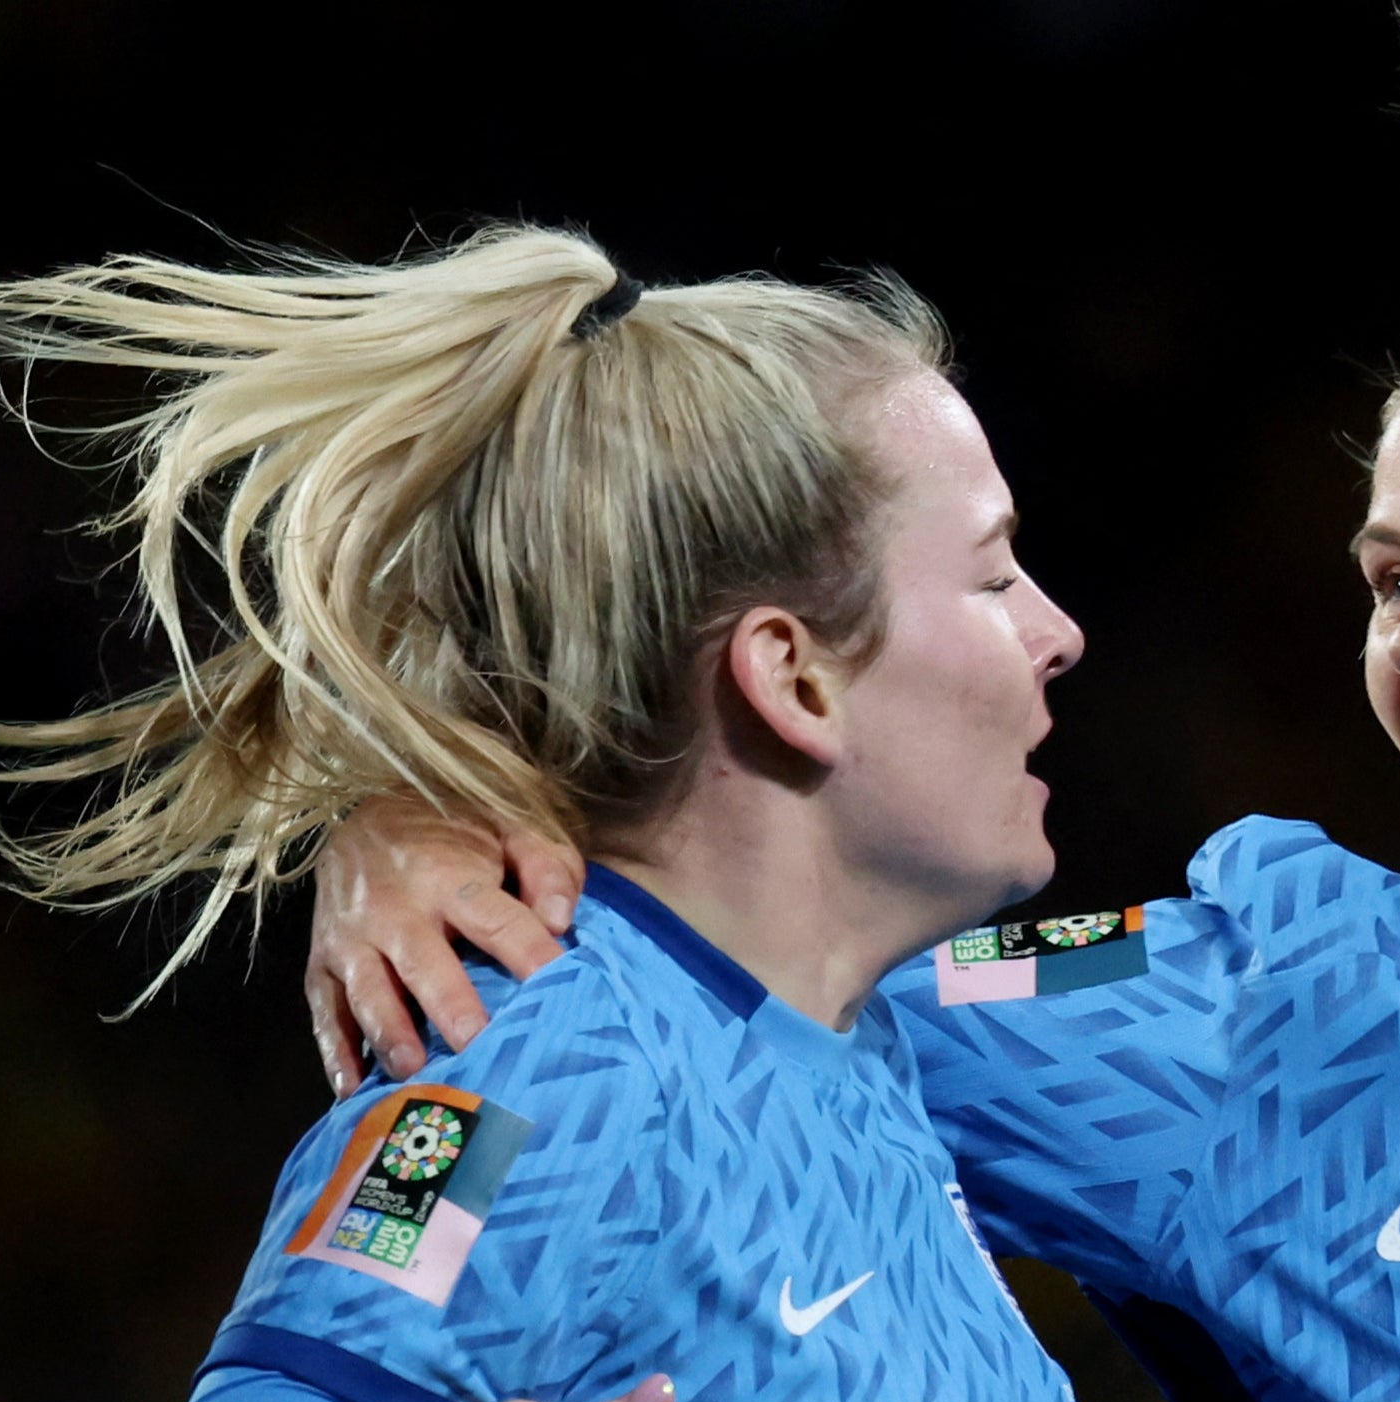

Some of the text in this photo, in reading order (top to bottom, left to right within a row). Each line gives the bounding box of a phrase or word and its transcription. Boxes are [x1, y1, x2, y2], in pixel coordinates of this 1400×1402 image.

[954, 939, 975, 960] 23
[974, 935, 995, 959] 20
[363, 1176, 389, 1190] FIFA
[340, 1212, 378, 1233] AU
[379, 1219, 417, 1245] 20
[332, 1229, 368, 1250] NZ
[368, 1240, 409, 1264] 23
